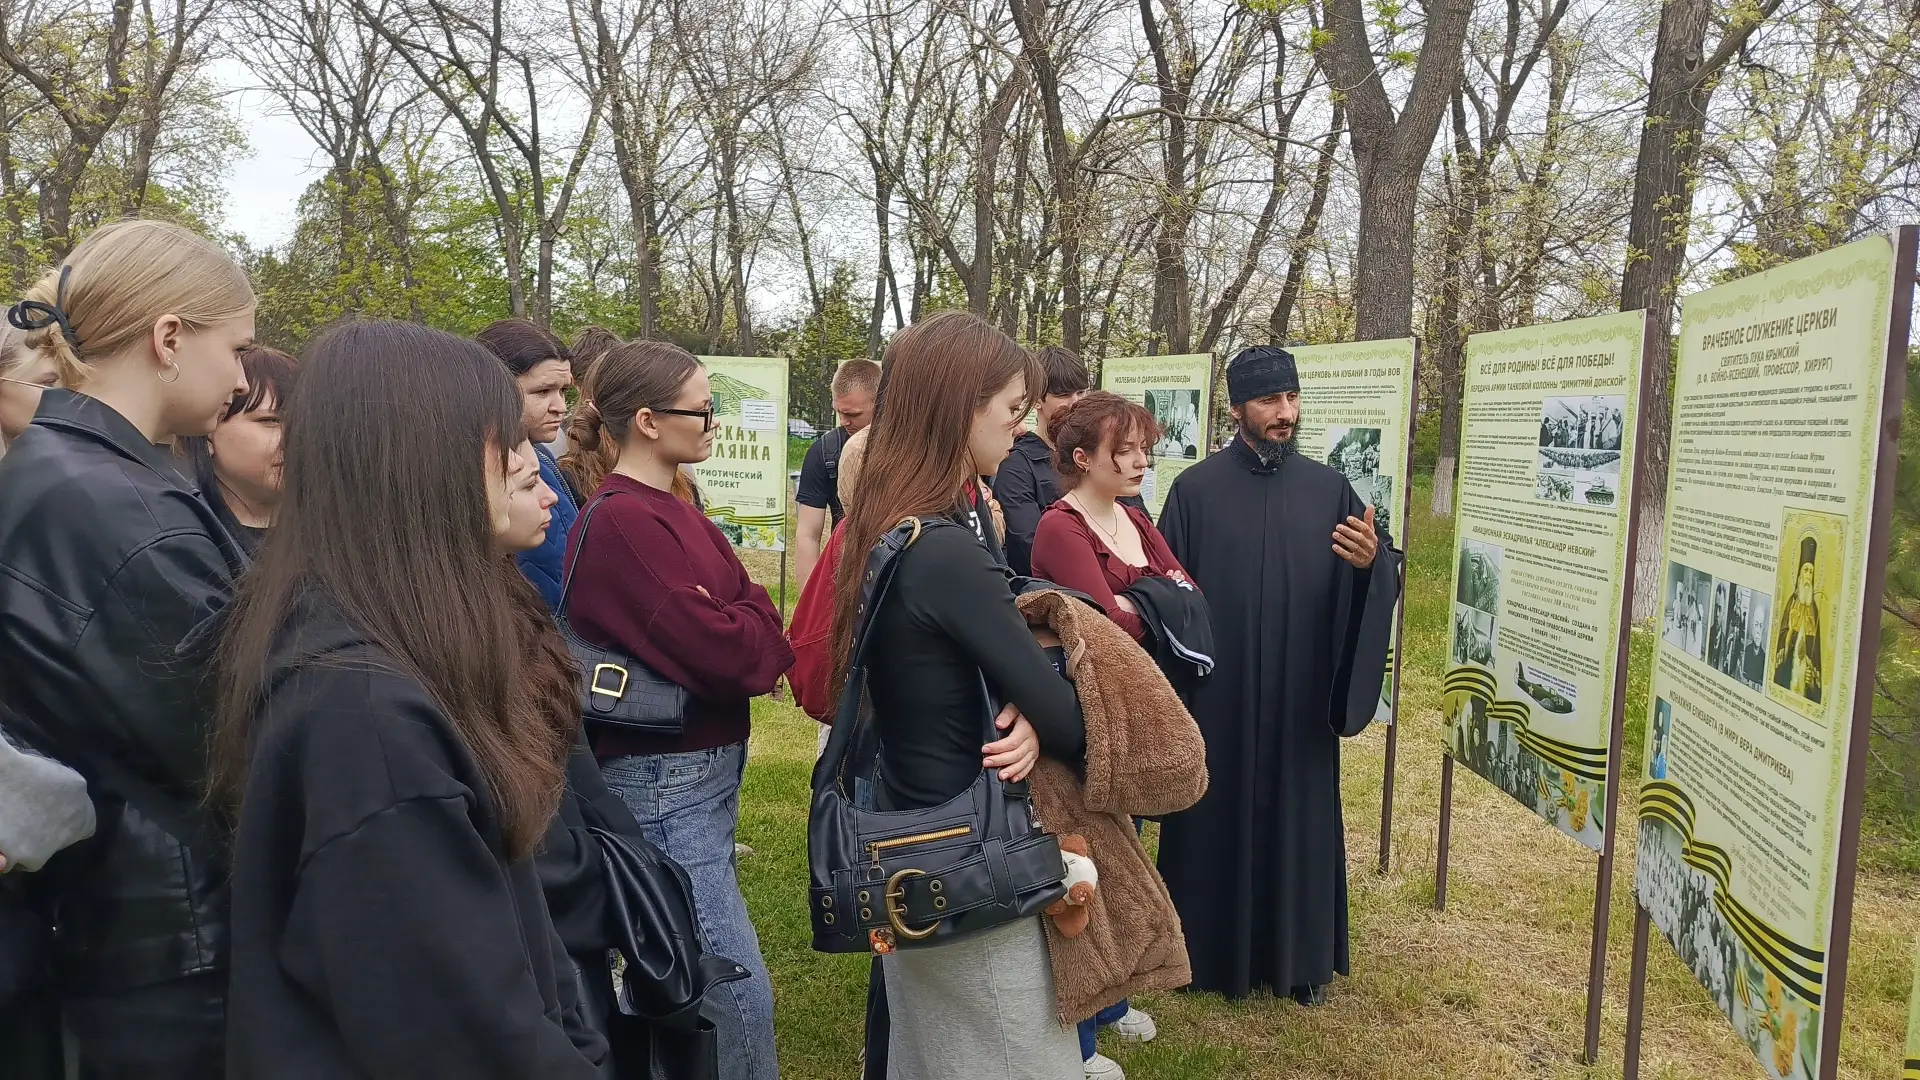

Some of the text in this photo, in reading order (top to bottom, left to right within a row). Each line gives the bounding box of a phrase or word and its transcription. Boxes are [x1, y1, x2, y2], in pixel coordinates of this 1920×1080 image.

[1702, 307, 1838, 351] ВРАЧЕБНОЕ СЛУЖЕНИЕ ЦЕРКВИ
[1720, 342, 1800, 367] СВЯТИТЕЛЬ ЛУКА КРЫМСКИЙ
[1480, 352, 1615, 376] ВСЁ ДЛЯ РОДИНЫ! ВСЁ ДЛЯ ПОБЕДЫ!
[1763, 361, 1800, 377] ПРОФЕССОР,
[1804, 357, 1833, 373] ХИРУРГ)
[1141, 375, 1169, 384] ДАРОВАНИИ
[1170, 375, 1191, 384] ПОБЕДЫ
[1308, 370, 1331, 380] ЦЕРКОВЬ
[1332, 370, 1340, 378] НА
[1341, 369, 1363, 378] КУБАНИ
[1364, 369, 1368, 377] В
[1369, 368, 1387, 378] ГОДЫ
[1388, 367, 1401, 376] ВОВ
[1470, 384, 1490, 393] ПЕРЕДАЧА
[1491, 383, 1506, 391] АРМИИ
[1507, 380, 1531, 391] ТАНКОВОЙ
[1533, 380, 1558, 390] КОЛОННЫ
[714, 426, 757, 442] СКАЯ
[710, 443, 771, 461] ЛЯНКА
[695, 468, 763, 480] ТРИОТИЧЕСКИЙ
[707, 480, 741, 489] ПРОЕКТ
[1472, 525, 1502, 538] АВИАЦИОННАЯ
[1503, 531, 1533, 545] ЭСКАДРИЛЬЯ
[1546, 622, 1577, 636] ПРАВОСЛАВНОЙ
[1577, 631, 1594, 642] ЦЕРКВИ
[1571, 619, 1591, 630] СОЗДАНА
[1669, 690, 1692, 712] МОНАХИНЯ
[1692, 704, 1718, 732] ЕЛИЗАВЕТА
[1718, 722, 1724, 736] (В
[1724, 726, 1740, 744] МИРУ
[1740, 736, 1753, 756] ВЕРА
[1753, 746, 1794, 785] ДМИТРИЕВА)
